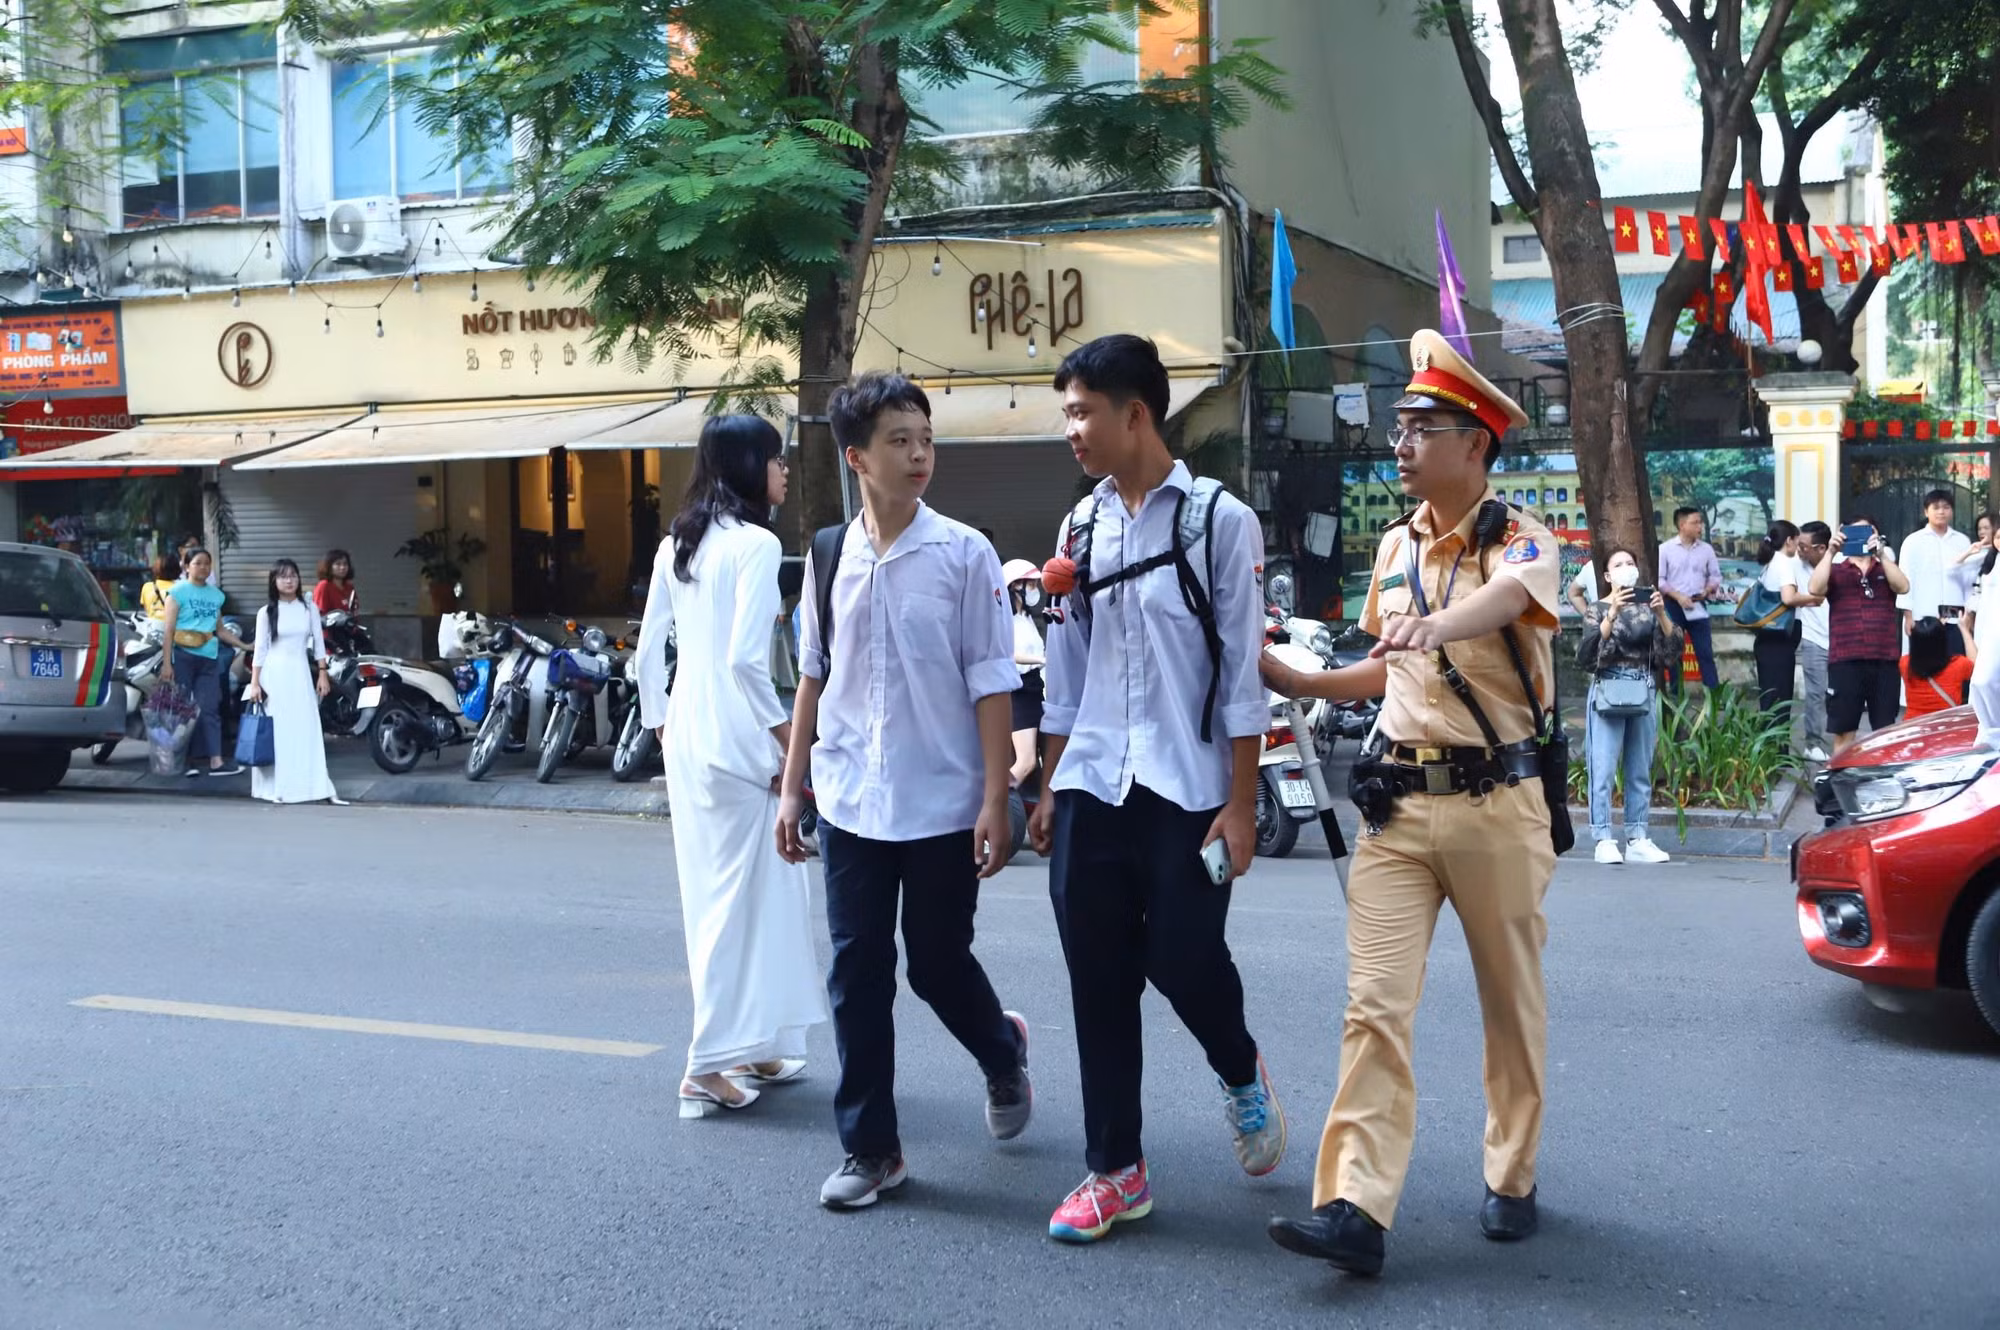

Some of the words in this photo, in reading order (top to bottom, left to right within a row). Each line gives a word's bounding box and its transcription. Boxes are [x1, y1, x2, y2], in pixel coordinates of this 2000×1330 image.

[519, 306, 598, 333] HƯƠN
[3, 352, 55, 370] PHÒNG
[24, 416, 62, 432] BACK
[66, 415, 85, 429] TO
[88, 412, 138, 429] SCHOO
[37, 650, 55, 663] 31A
[33, 662, 60, 677] 7646
